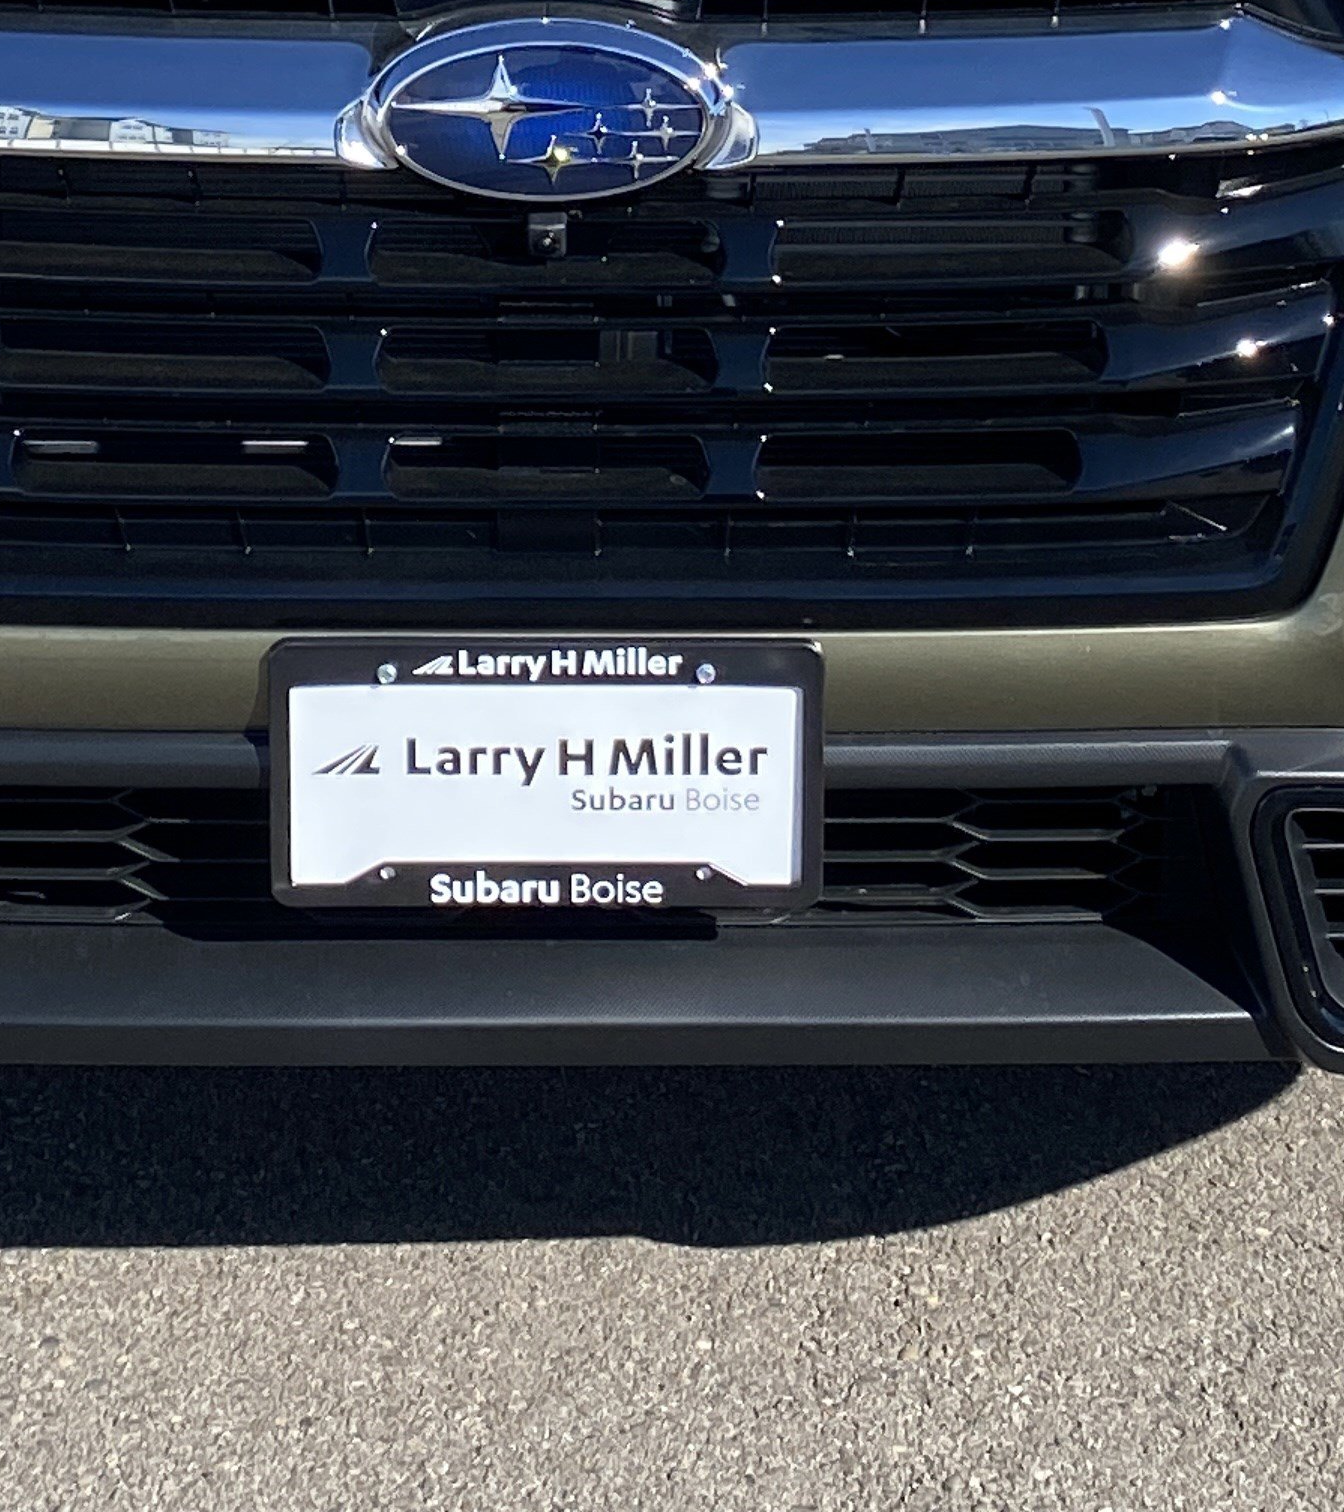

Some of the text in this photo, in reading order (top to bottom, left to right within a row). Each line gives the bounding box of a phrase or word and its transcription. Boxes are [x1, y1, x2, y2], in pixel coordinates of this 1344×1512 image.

[458, 647, 684, 682] Larry H Miller
[406, 733, 768, 786] Larry H Miller
[571, 787, 760, 811] Subaru Boise
[429, 871, 664, 903] Subaru Boise
